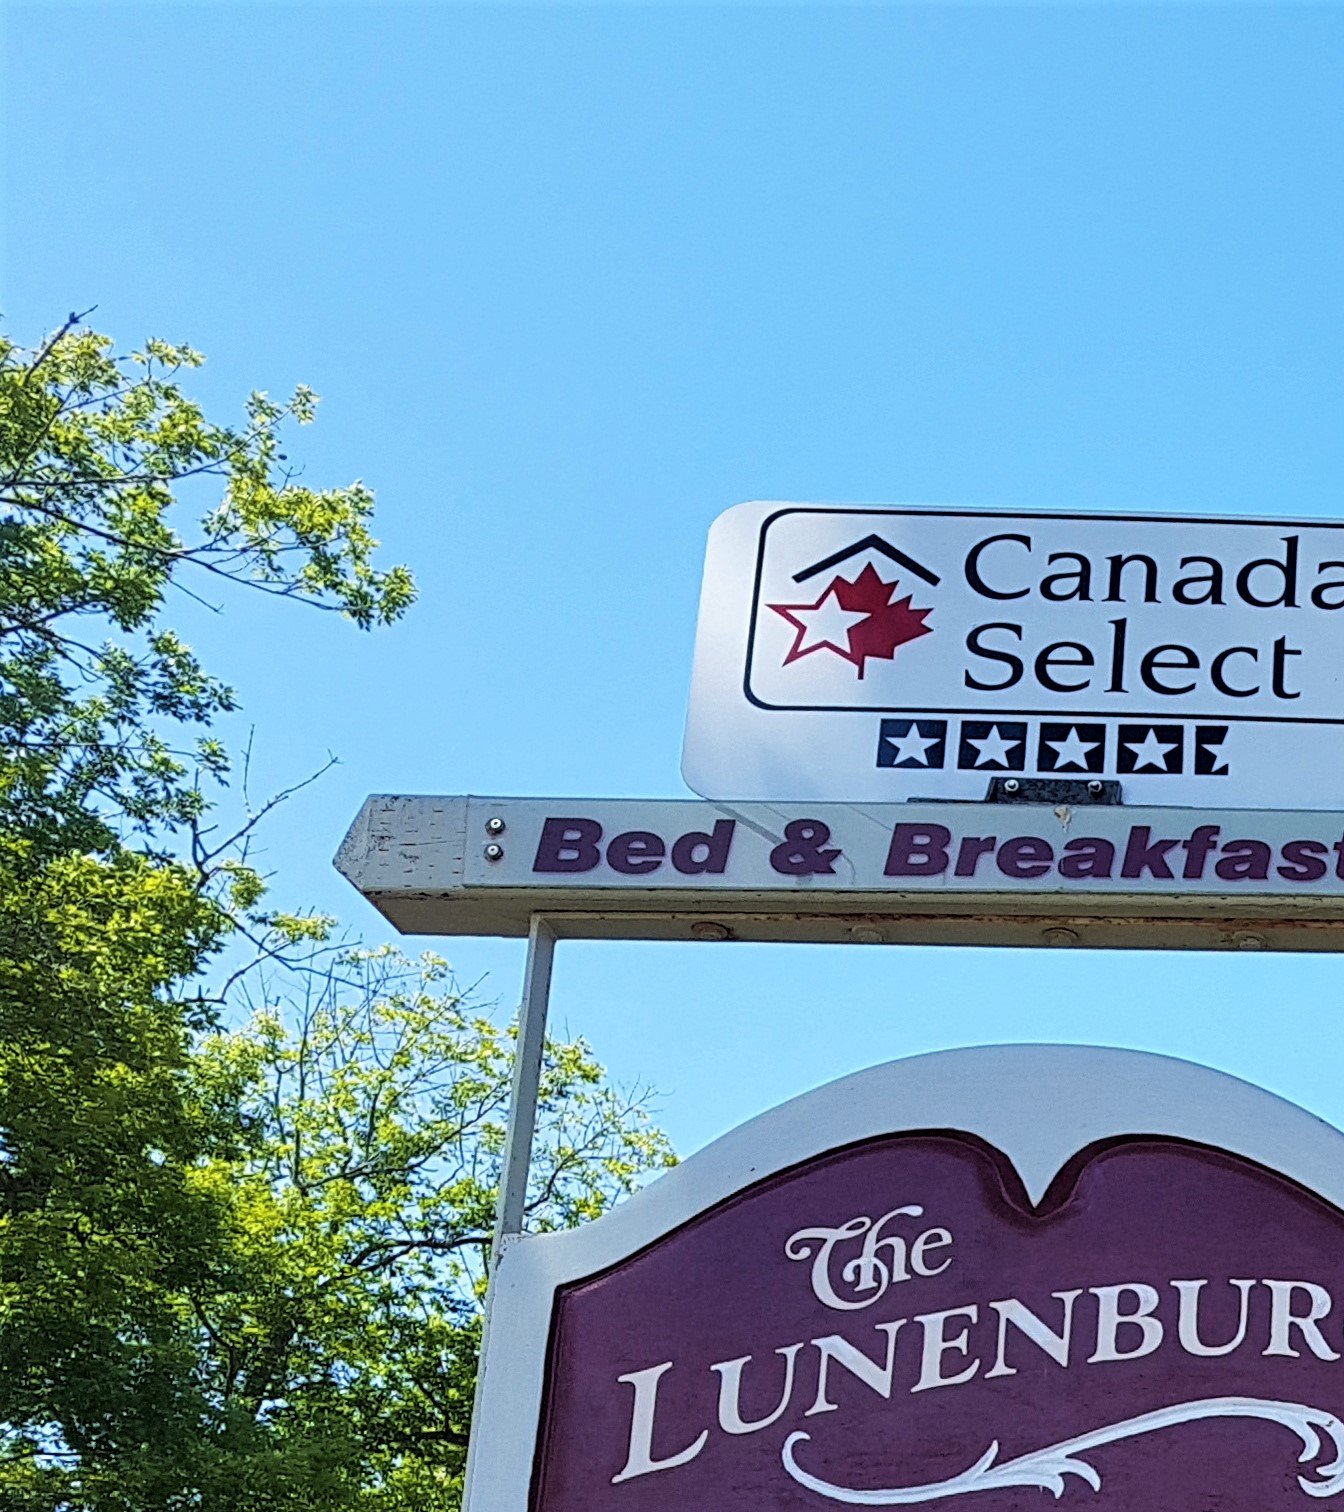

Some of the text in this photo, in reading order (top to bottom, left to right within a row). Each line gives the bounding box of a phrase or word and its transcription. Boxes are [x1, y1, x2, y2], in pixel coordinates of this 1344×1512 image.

[963, 617, 1302, 700] Select
[532, 817, 736, 875] Bed
[768, 817, 842, 876] &
[785, 1205, 953, 1311] The
